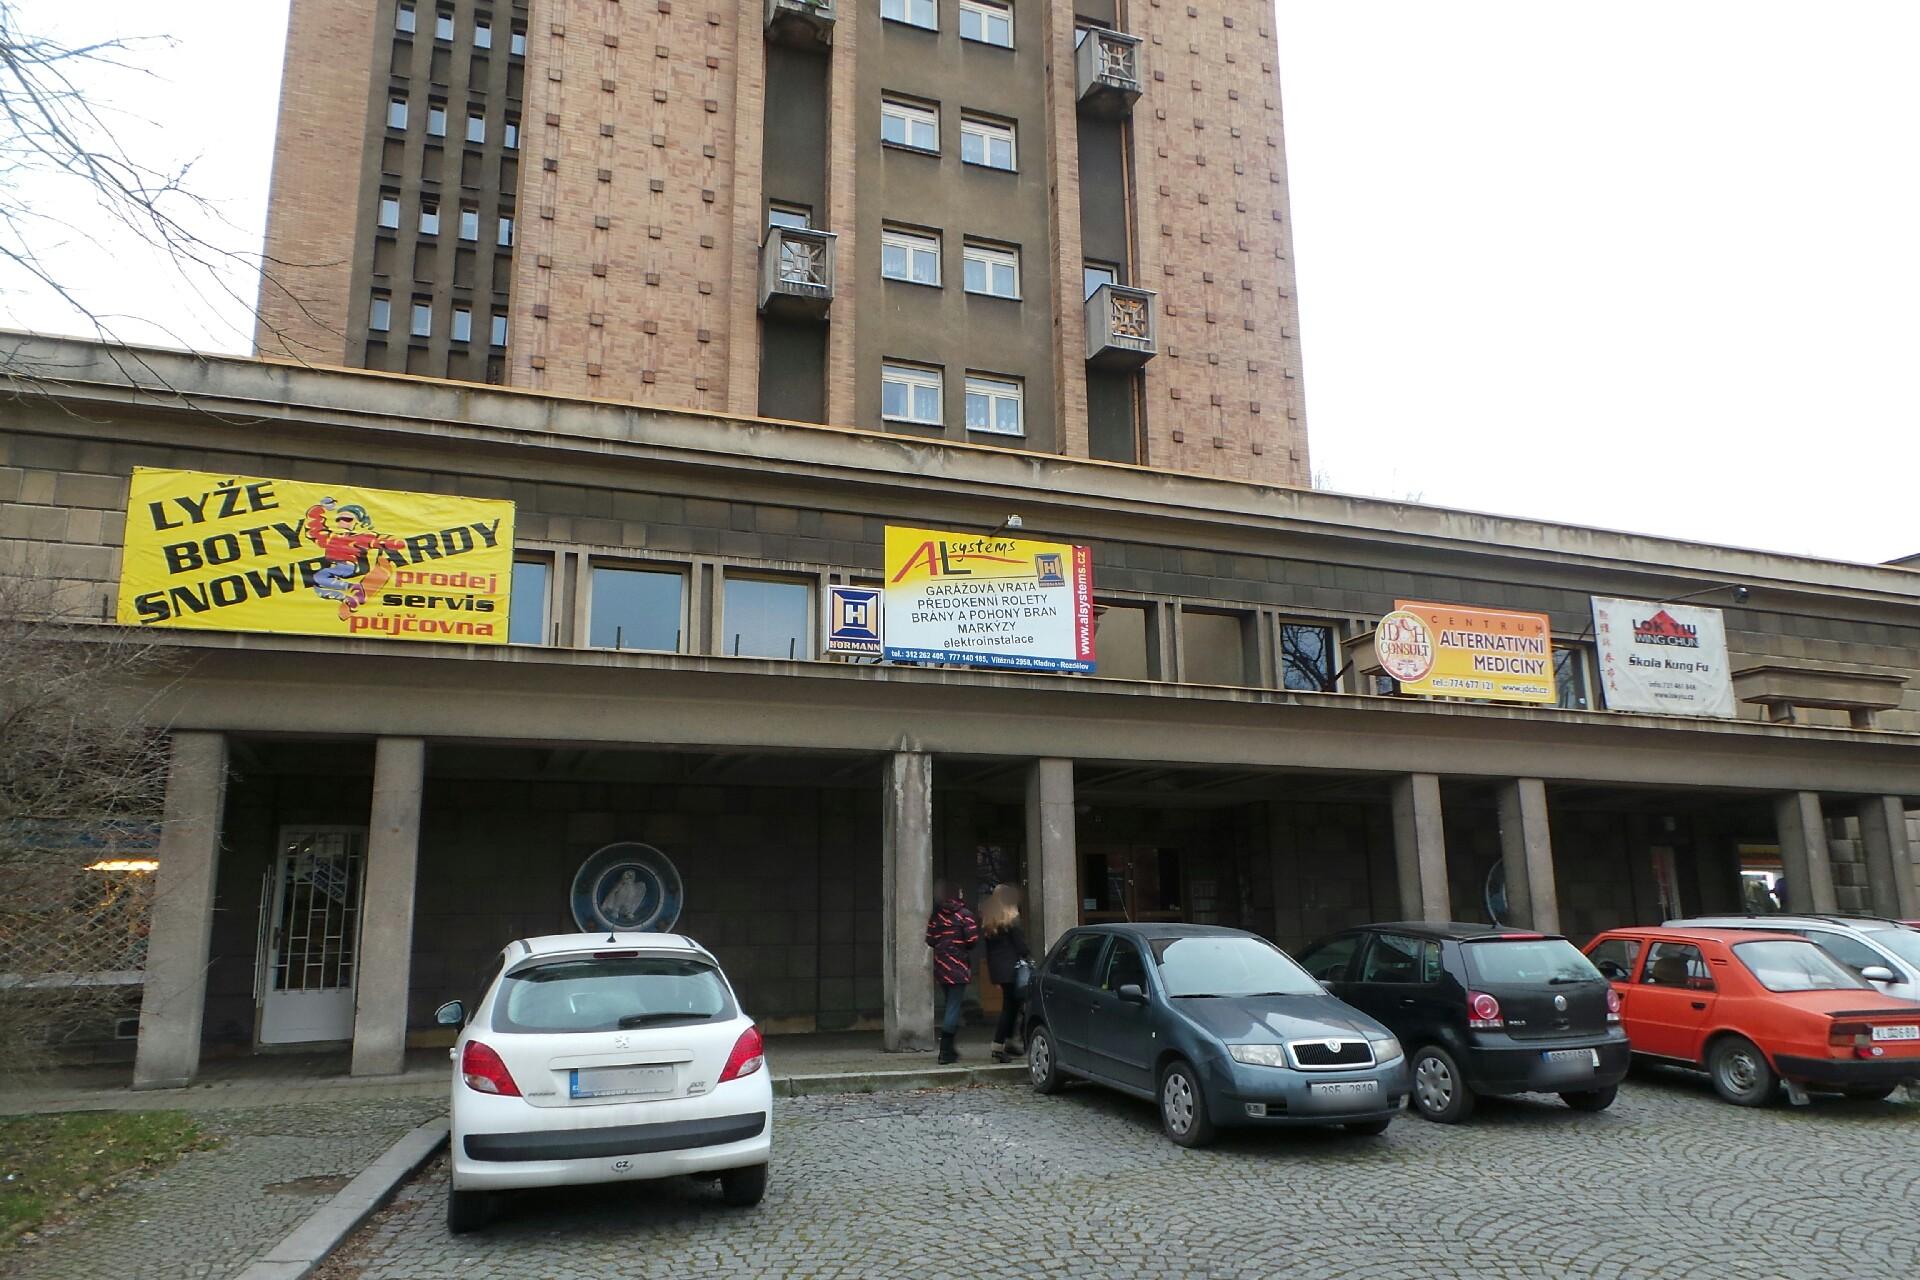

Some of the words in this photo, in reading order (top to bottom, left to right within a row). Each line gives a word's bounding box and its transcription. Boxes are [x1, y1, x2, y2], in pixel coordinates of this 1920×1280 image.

[149, 480, 279, 530] LYŽE
[163, 518, 305, 575] BOTY
[395, 571, 496, 594] prodej
[926, 581, 995, 596] GARÁŽOVÁ
[998, 582, 1036, 593] VRATA
[382, 594, 495, 612] servis
[917, 594, 998, 610] PŘEDOKENNÍ
[1001, 594, 1048, 606] ROLETY
[1077, 551, 1091, 656] www.alsystems.cz
[912, 610, 954, 623] BRÁNY
[958, 611, 967, 621] A
[969, 608, 1020, 621] POHONY
[349, 612, 494, 636] půjčovna
[957, 619, 1016, 634] MARKÝZY
[1431, 616, 1542, 632] CENTRUM
[1632, 619, 1664, 632] LOK
[943, 634, 1034, 648] elektroinstalace
[1635, 633, 1665, 645] WING
[1668, 636, 1698, 648] CHUN
[1381, 641, 1429, 657] CONSULT
[905, 650, 918, 659] 312
[949, 653, 960, 661] 777
[1033, 658, 1055, 667] Kladno
[1474, 654, 1545, 675] MEDICÍNY
[1629, 654, 1661, 668] Škola
[1664, 659, 1693, 672] Kung
[1696, 662, 1708, 672] Fu
[615, 1160, 629, 1169] CZ
